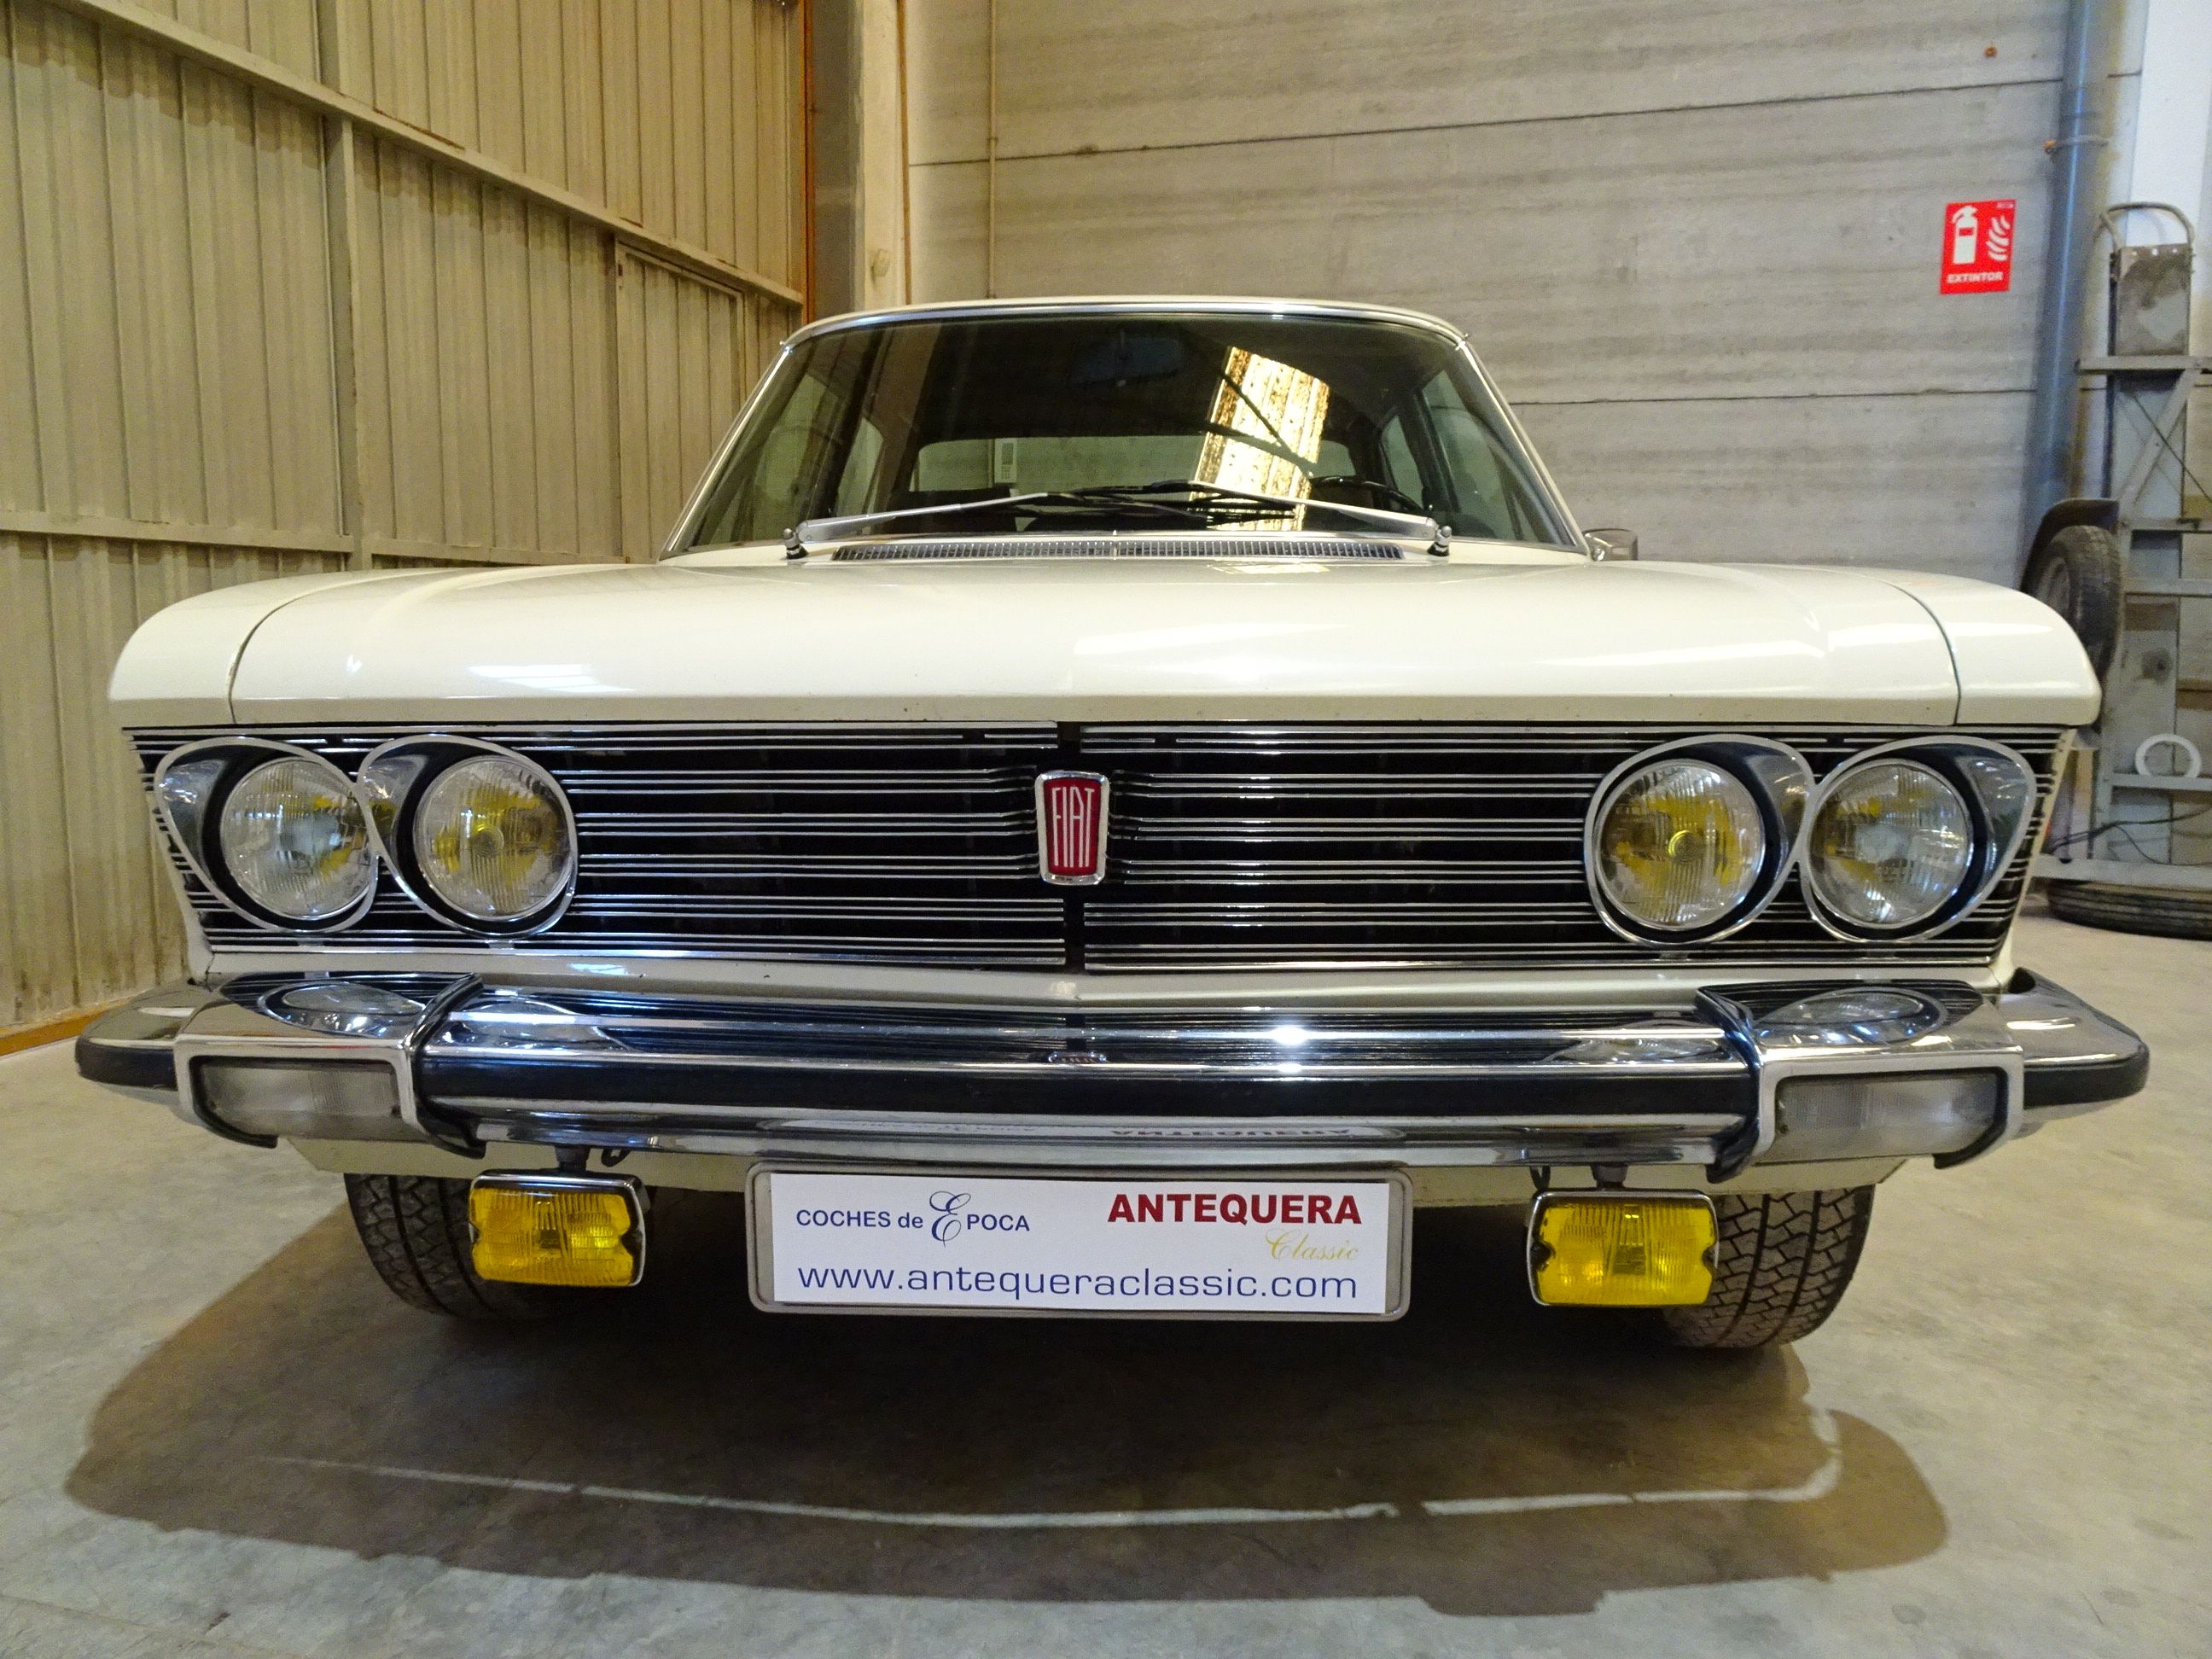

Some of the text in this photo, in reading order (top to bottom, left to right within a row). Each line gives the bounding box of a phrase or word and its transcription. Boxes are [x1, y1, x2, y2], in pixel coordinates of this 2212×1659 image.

[1947, 271, 2003, 283] EXTINTOR
[1051, 786, 1095, 868] FIAT
[796, 1209, 891, 1228] COCHES
[898, 1212, 923, 1229] de
[1108, 1193, 1362, 1225] ANTEQUERA
[1266, 1229, 1359, 1260] Classic
[798, 1266, 1356, 1300] www.antequeraclassic.com
